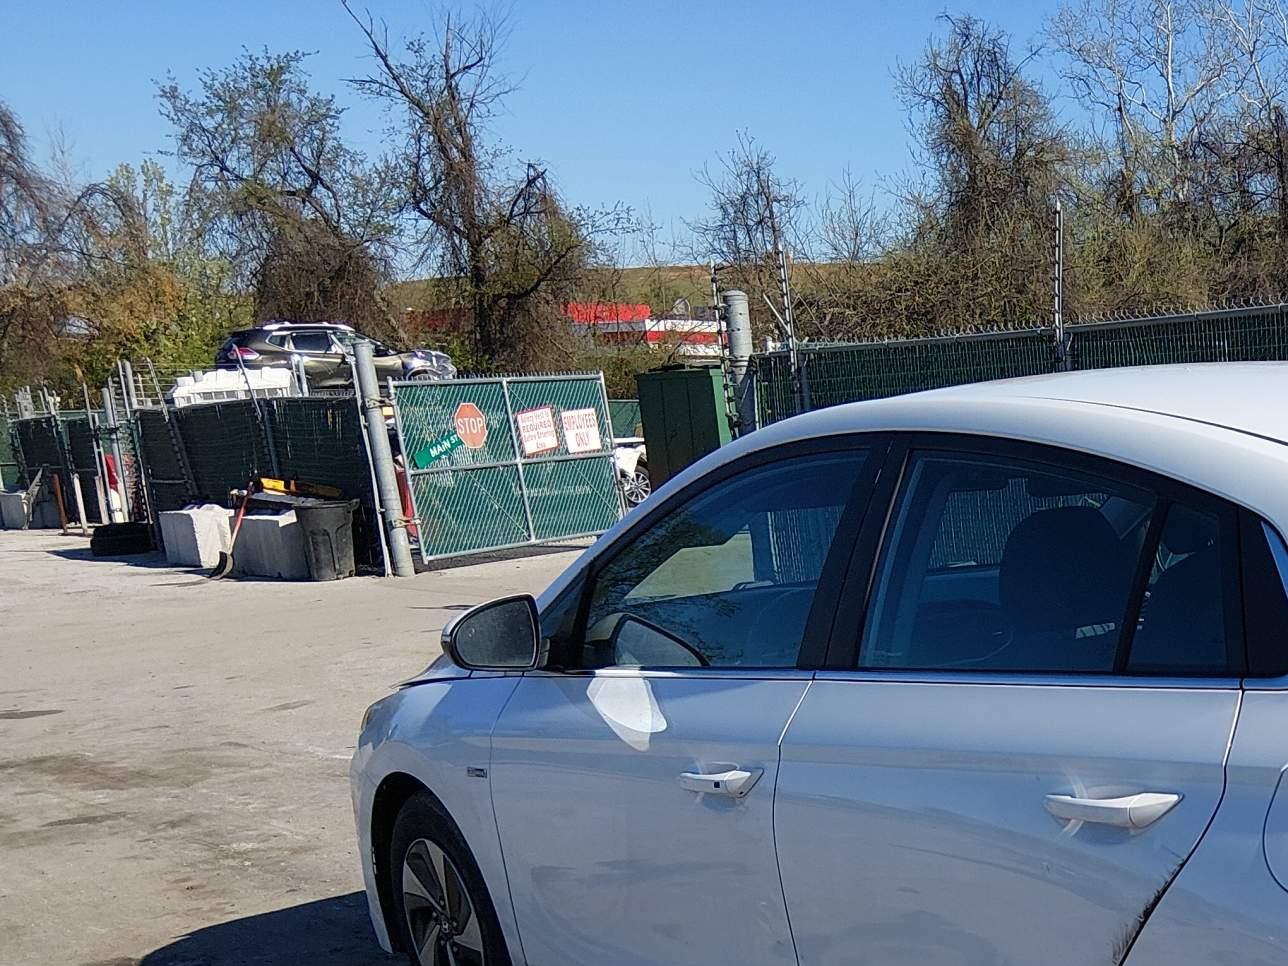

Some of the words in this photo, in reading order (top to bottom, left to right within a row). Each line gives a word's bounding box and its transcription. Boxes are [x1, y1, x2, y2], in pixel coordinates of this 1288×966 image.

[457, 417, 483, 434] STOP
[521, 420, 552, 434] REQUIRED
[563, 412, 596, 431] EMPLOYEES
[575, 430, 591, 448] ONLY
[430, 439, 452, 458] MAIN
